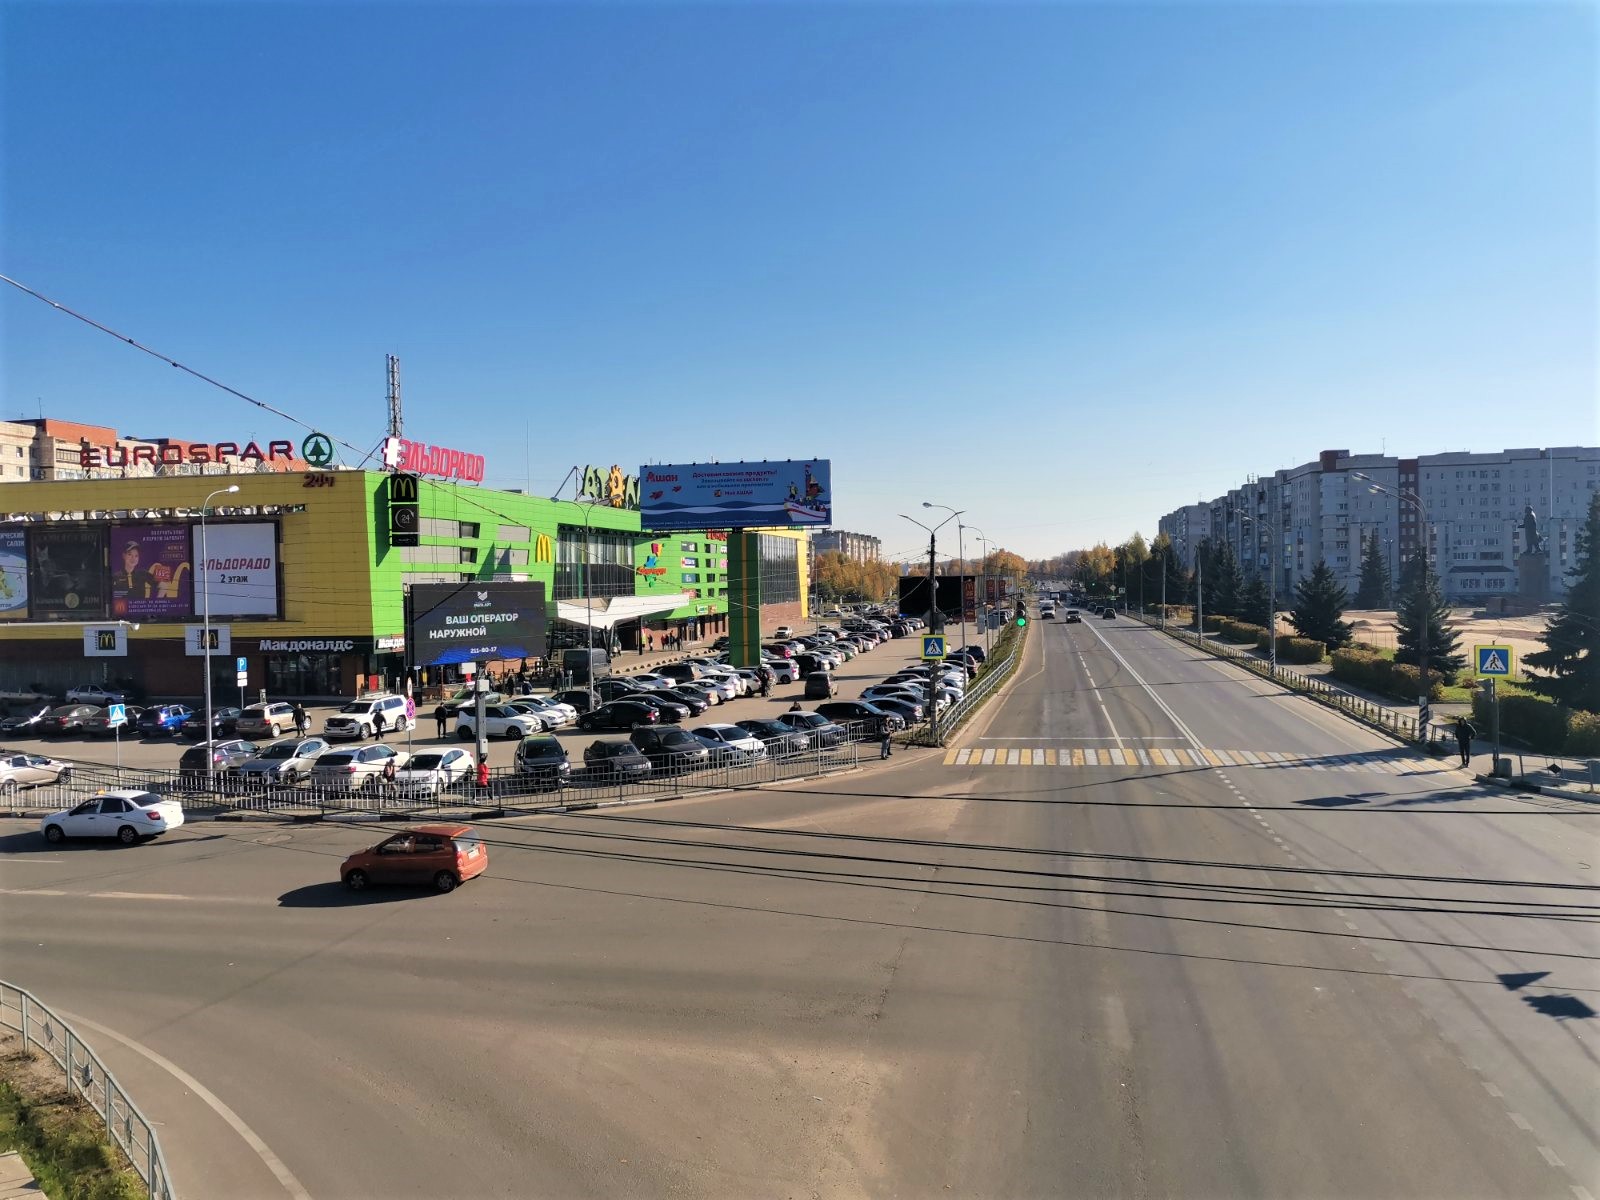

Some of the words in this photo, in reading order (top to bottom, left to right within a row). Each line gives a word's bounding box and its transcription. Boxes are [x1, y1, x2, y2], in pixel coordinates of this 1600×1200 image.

[80, 439, 294, 468] EUROSPAR
[399, 438, 485, 482] ЭЛЬДОРАДО
[646, 471, 678, 483] Ашан
[220, 573, 226, 583] 2
[228, 575, 248, 583] этаж
[445, 615, 468, 625] ВАШ
[470, 613, 519, 623] ОПЕРАТОР
[429, 625, 487, 639] НАРУЖНОЙ
[259, 639, 353, 652] Макдоналдс
